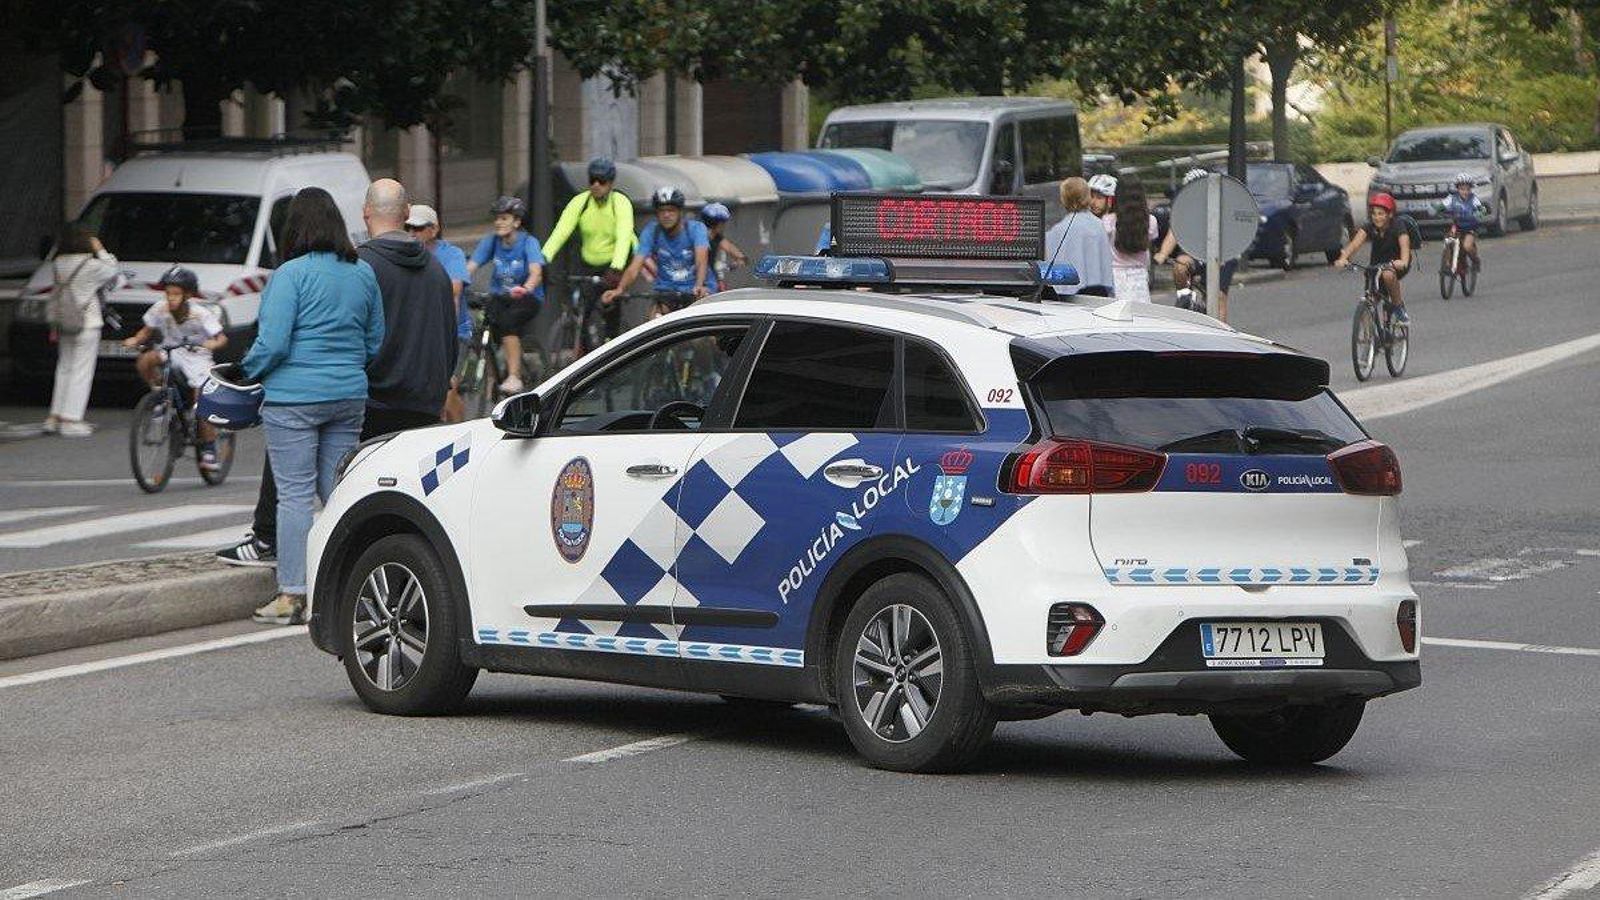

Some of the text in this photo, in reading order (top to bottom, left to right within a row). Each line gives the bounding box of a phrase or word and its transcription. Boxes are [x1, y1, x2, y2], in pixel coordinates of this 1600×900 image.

[987, 389, 1013, 403] 092
[1186, 463, 1221, 484] 092
[1245, 473, 1268, 486] KIA
[1311, 476, 1333, 485] LOCAL
[778, 457, 921, 604] POLICÍA LOCAL
[1216, 627, 1316, 653] 7712 LPV
